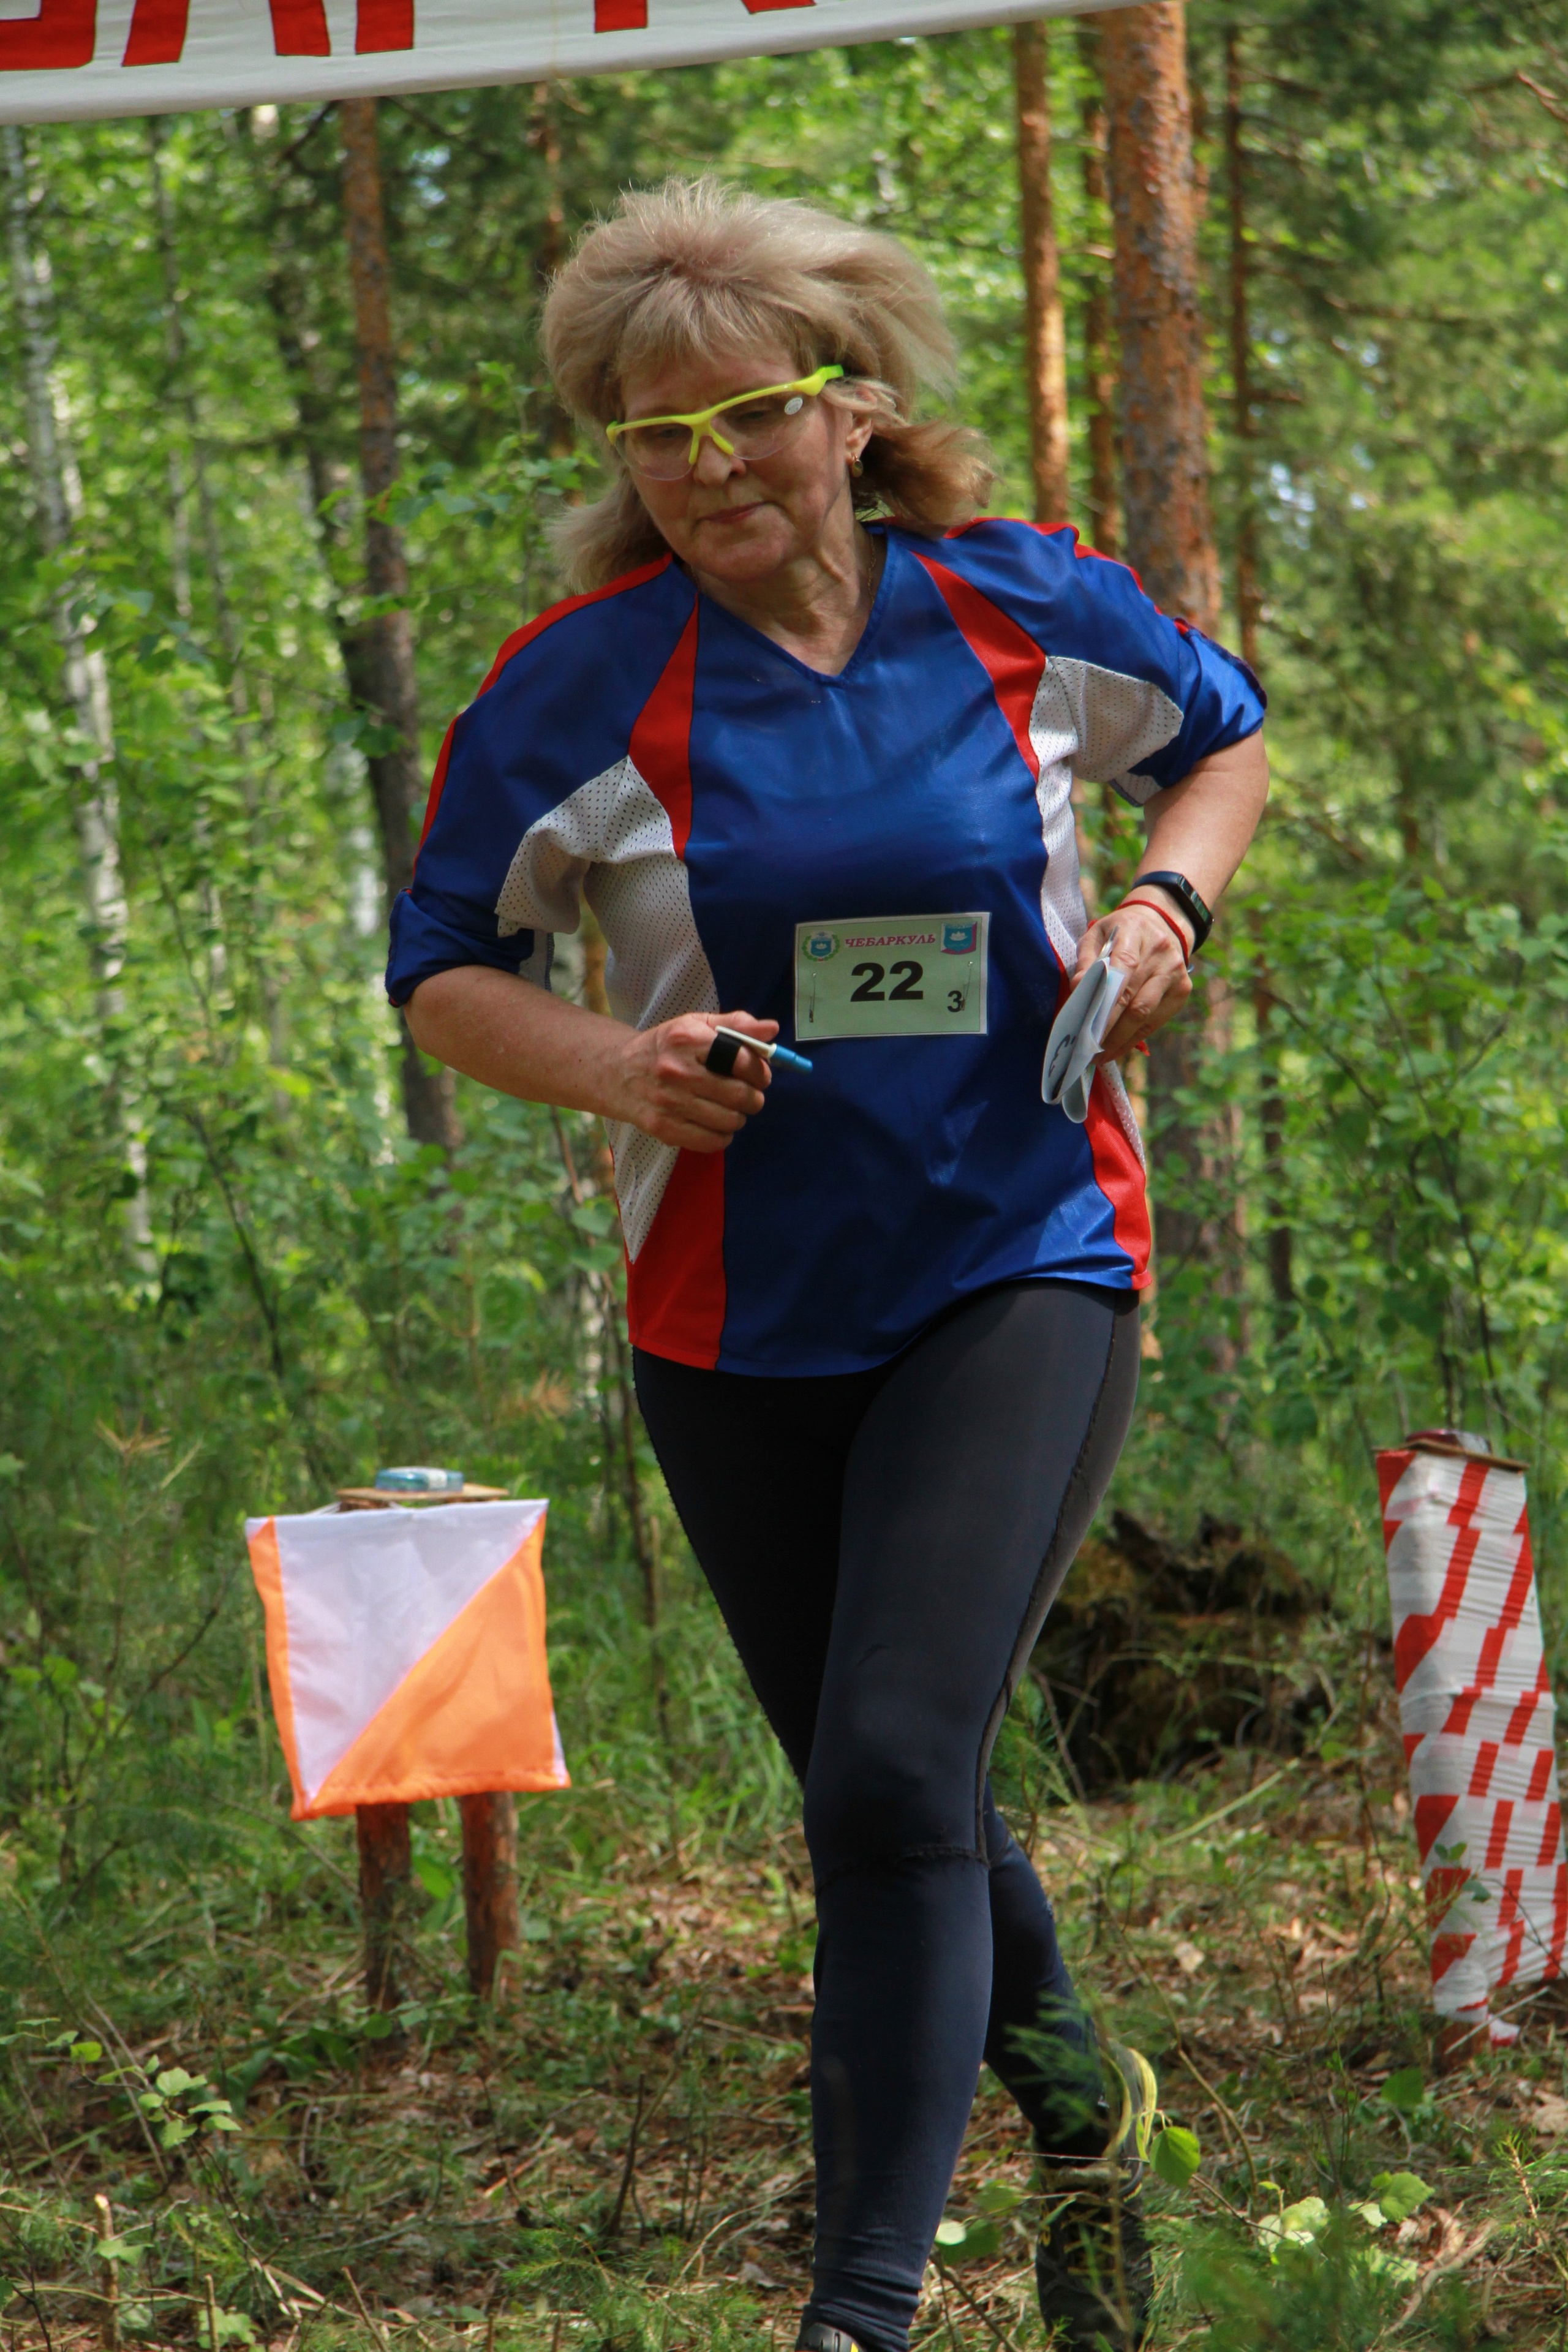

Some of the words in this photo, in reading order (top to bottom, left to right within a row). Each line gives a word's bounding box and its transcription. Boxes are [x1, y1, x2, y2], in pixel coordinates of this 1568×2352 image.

[845, 934, 936, 948] ЧЕБАРКУЛЬ
[850, 960, 924, 1002] 22
[947, 990, 962, 1012] 3
